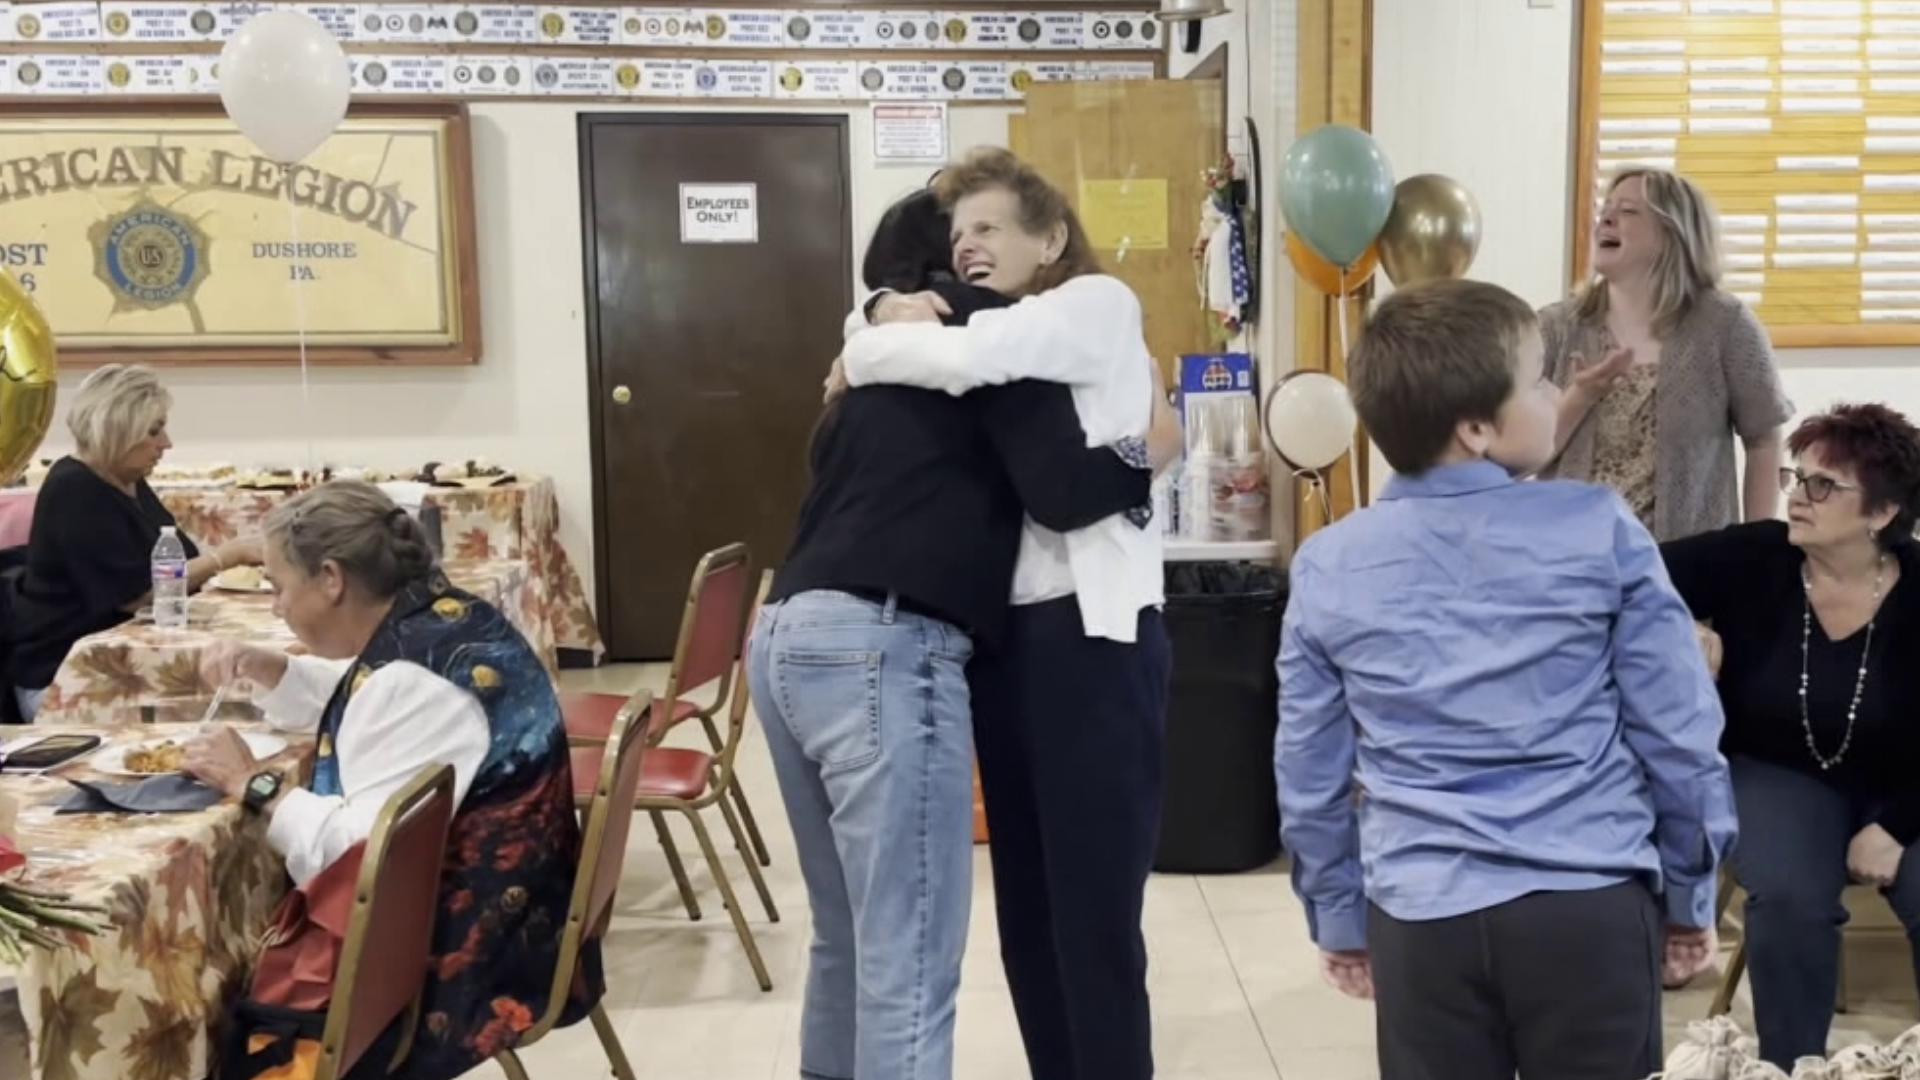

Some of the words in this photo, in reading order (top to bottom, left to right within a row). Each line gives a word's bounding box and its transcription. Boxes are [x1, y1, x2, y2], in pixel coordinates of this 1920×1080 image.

[208, 149, 417, 240] LEGION
[687, 196, 749, 210] EMPLOYEES
[696, 211, 739, 223] ONLY!
[252, 242, 357, 259] DUSHORE
